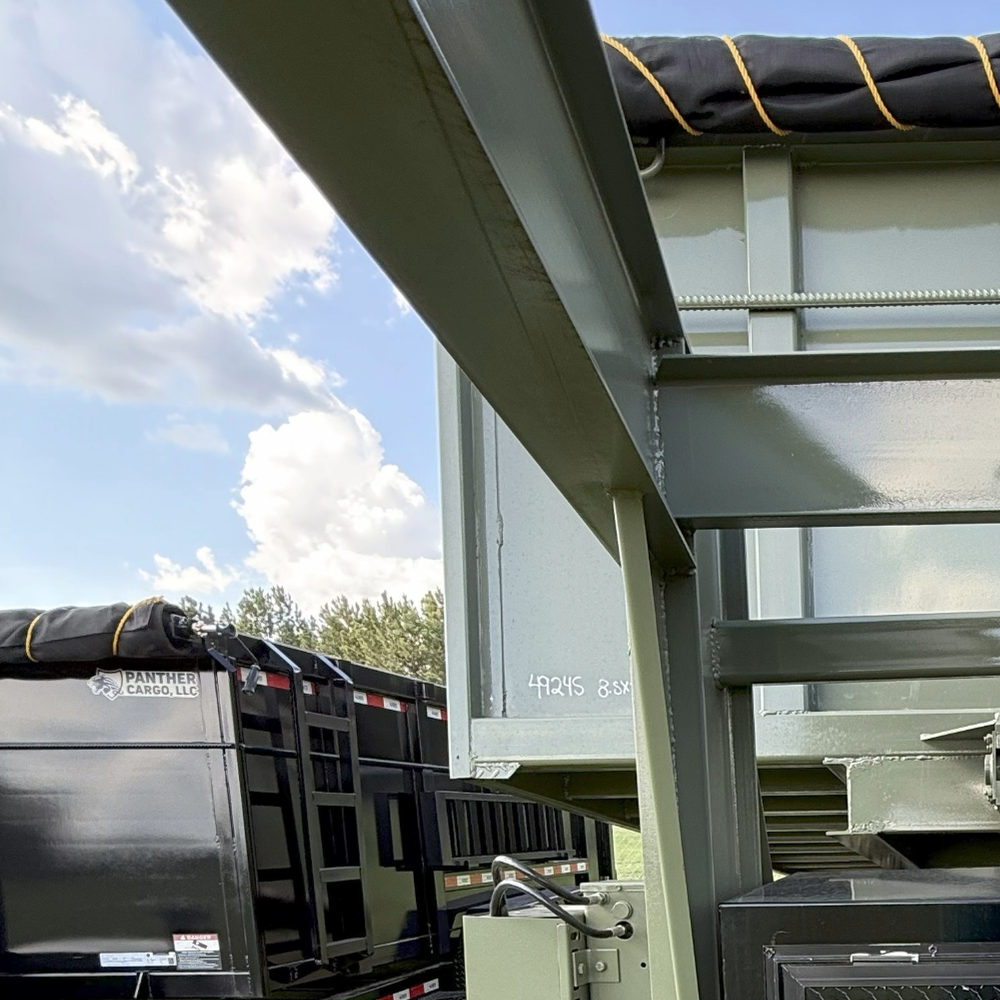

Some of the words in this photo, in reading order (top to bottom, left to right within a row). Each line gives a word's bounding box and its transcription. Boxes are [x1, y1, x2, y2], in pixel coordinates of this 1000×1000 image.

[125, 671, 197, 685] PANTHER
[127, 684, 173, 697] CARGO,
[176, 685, 198, 696] LLC
[528, 673, 585, 699] 49245
